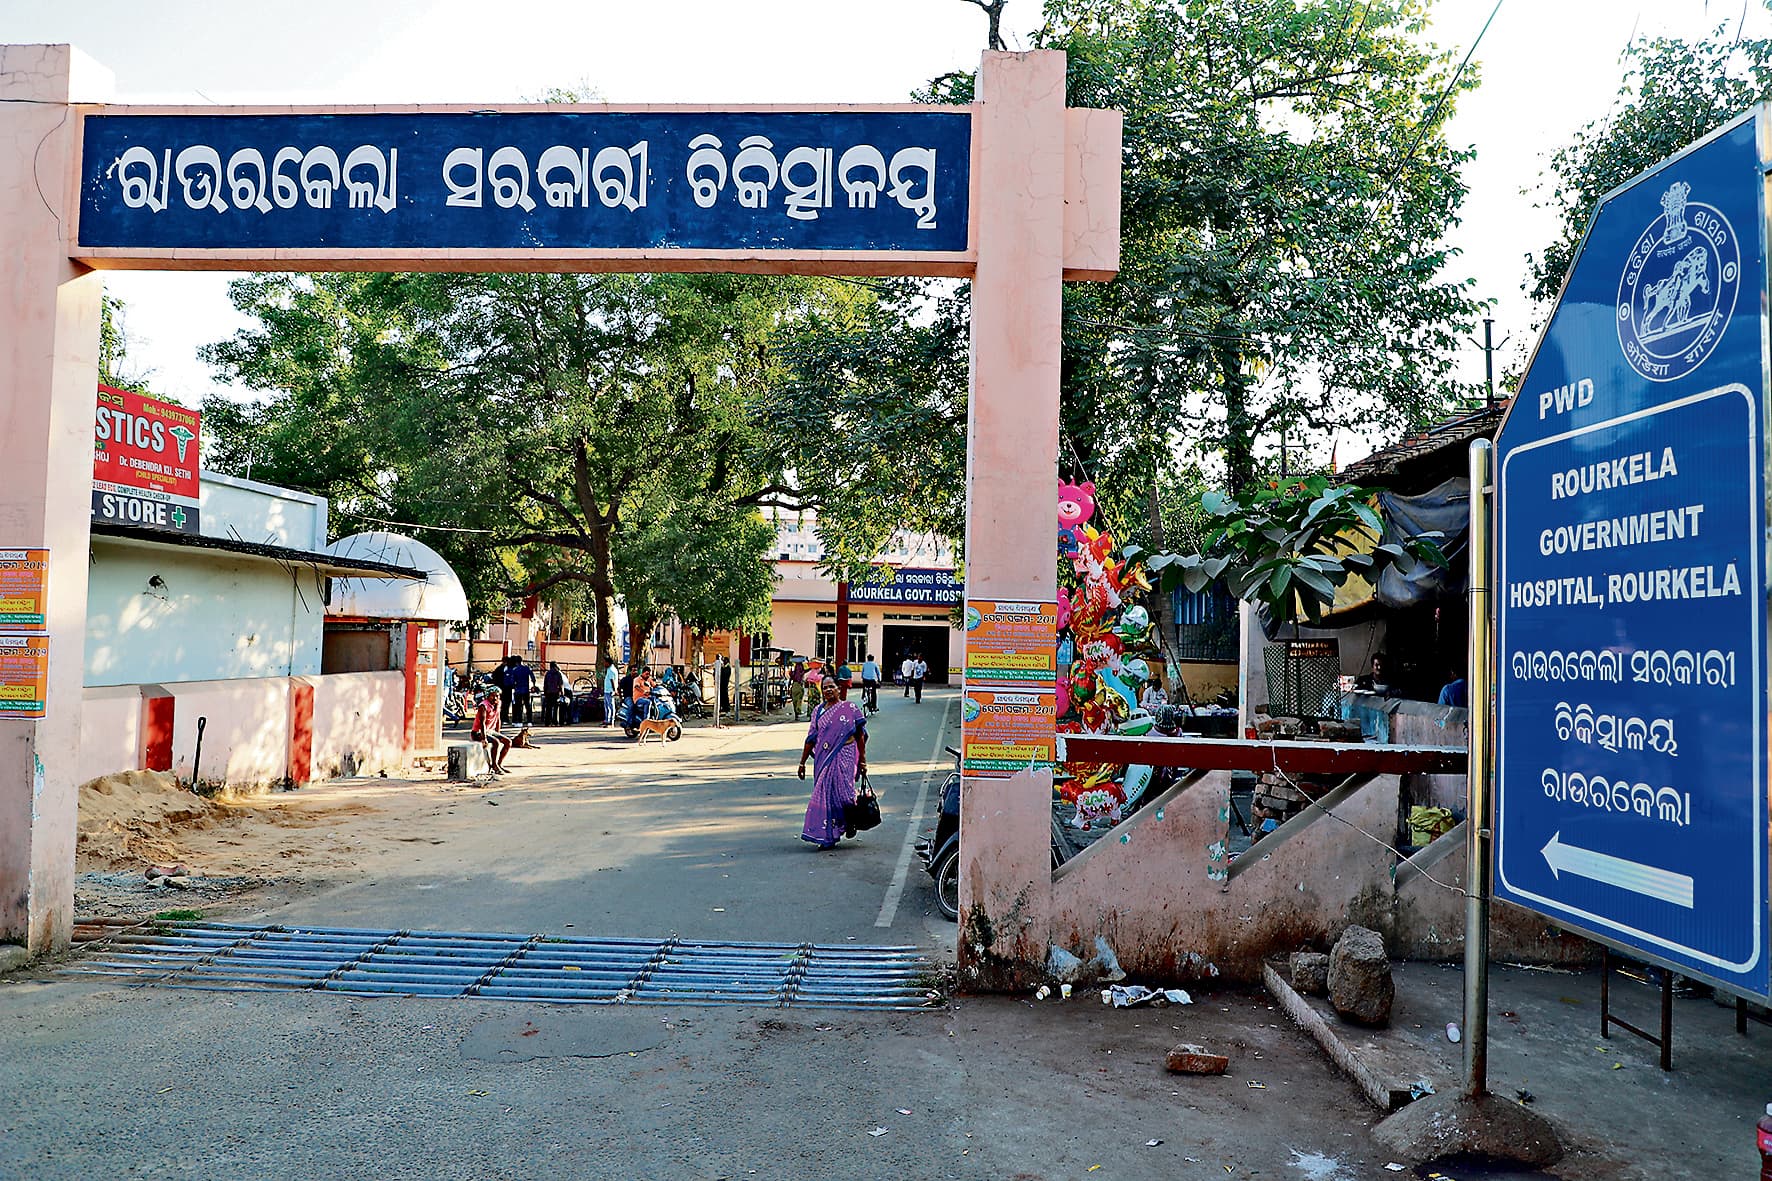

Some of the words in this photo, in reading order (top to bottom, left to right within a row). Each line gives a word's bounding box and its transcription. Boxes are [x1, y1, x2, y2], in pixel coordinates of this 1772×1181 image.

[118, 144, 398, 214] ରାଉରକେଲା
[443, 140, 649, 213] ସରକାରୀ
[686, 133, 937, 229] ଚିକିତ୍ସାଳୟ
[1539, 377, 1595, 420] PWD
[96, 406, 165, 453] STICS
[95, 450, 110, 463] HOJ
[1551, 446, 1678, 500] ROURKELA
[103, 494, 167, 526] STORE
[1539, 504, 1704, 557] GOVERNMENT
[23, 561, 47, 570] 2019
[1510, 575, 1604, 609] HOSPITAL,
[1608, 563, 1742, 603] ROURKELA
[850, 587, 903, 601] ROURKELA
[904, 588, 933, 602] GOVT.
[23, 648, 47, 657] 2019
[1512, 650, 1623, 684] ରାଉରକେଲା
[1630, 649, 1736, 689] ସରକାରୀ
[1554, 701, 1679, 757] ଚିକିତ୍ସାଳୟ
[1541, 768, 1691, 827] ରାଉରକେଲା
